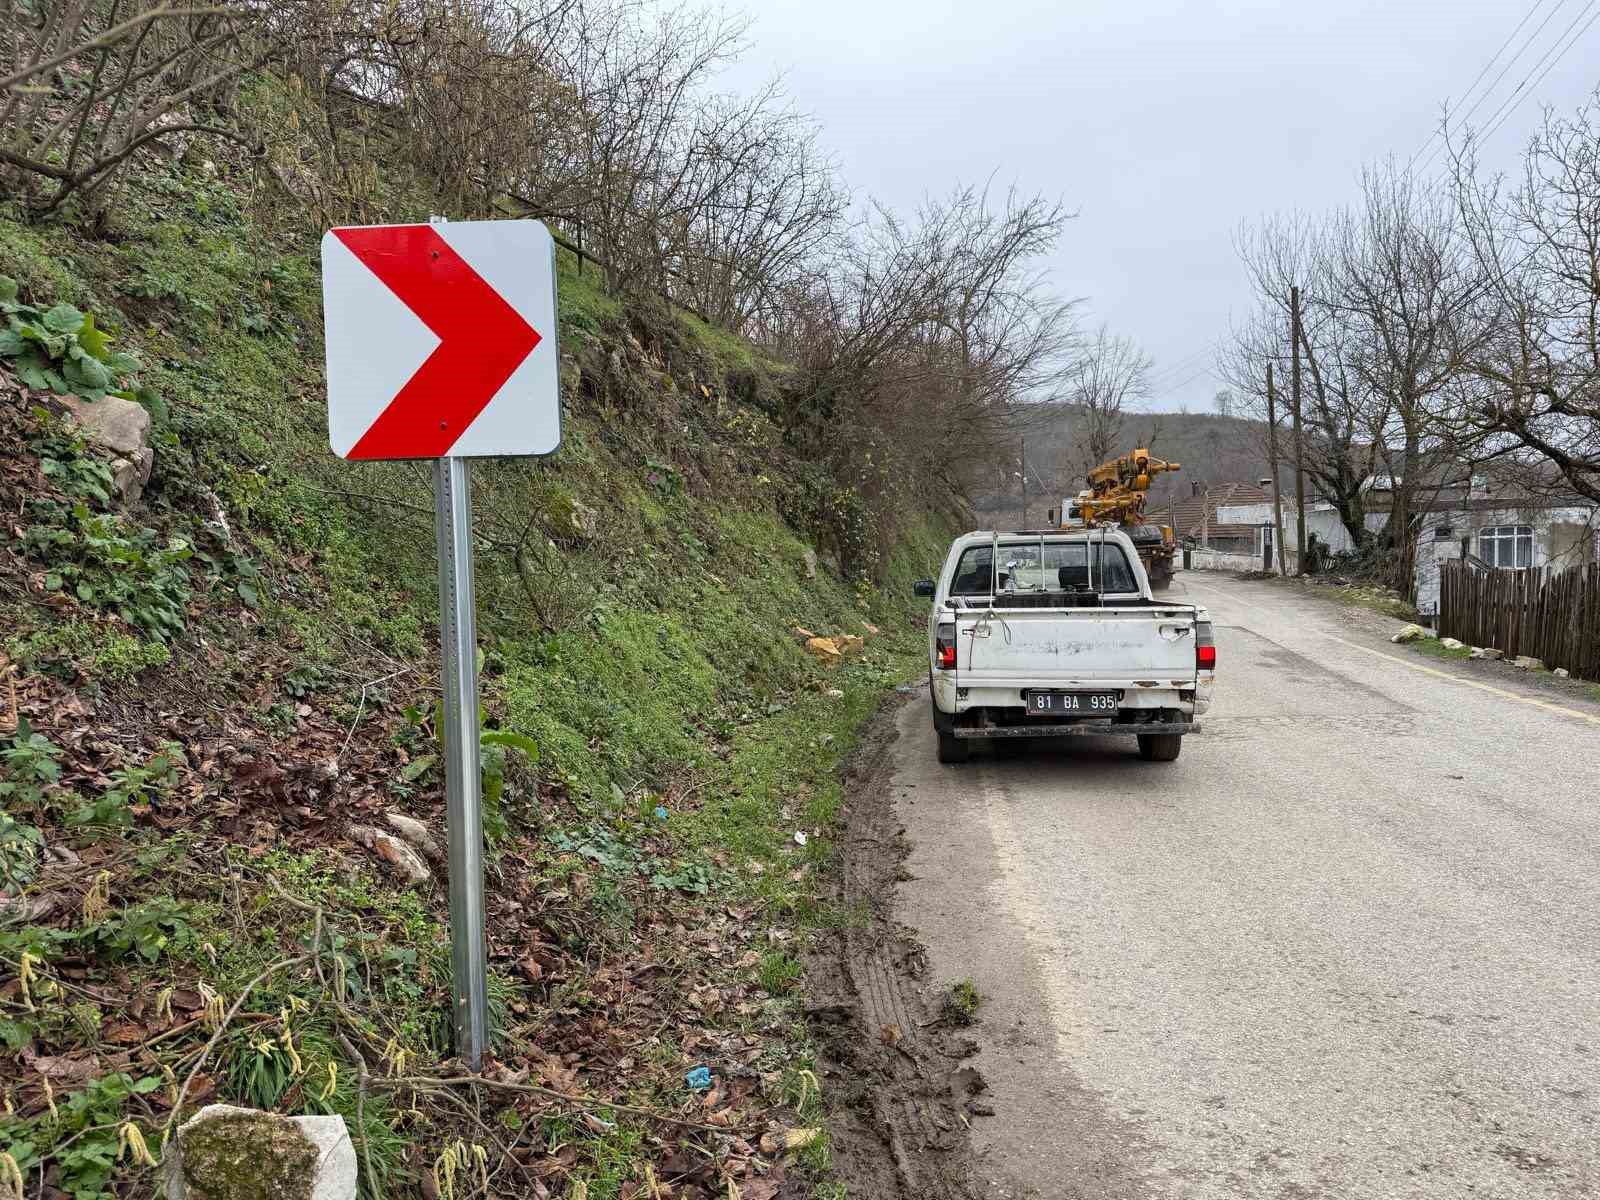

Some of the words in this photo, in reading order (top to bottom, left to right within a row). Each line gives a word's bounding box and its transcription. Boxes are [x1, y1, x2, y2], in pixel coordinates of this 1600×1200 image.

[1037, 695, 1051, 709] 81
[1063, 695, 1080, 709] BA
[1091, 695, 1115, 709] 935
